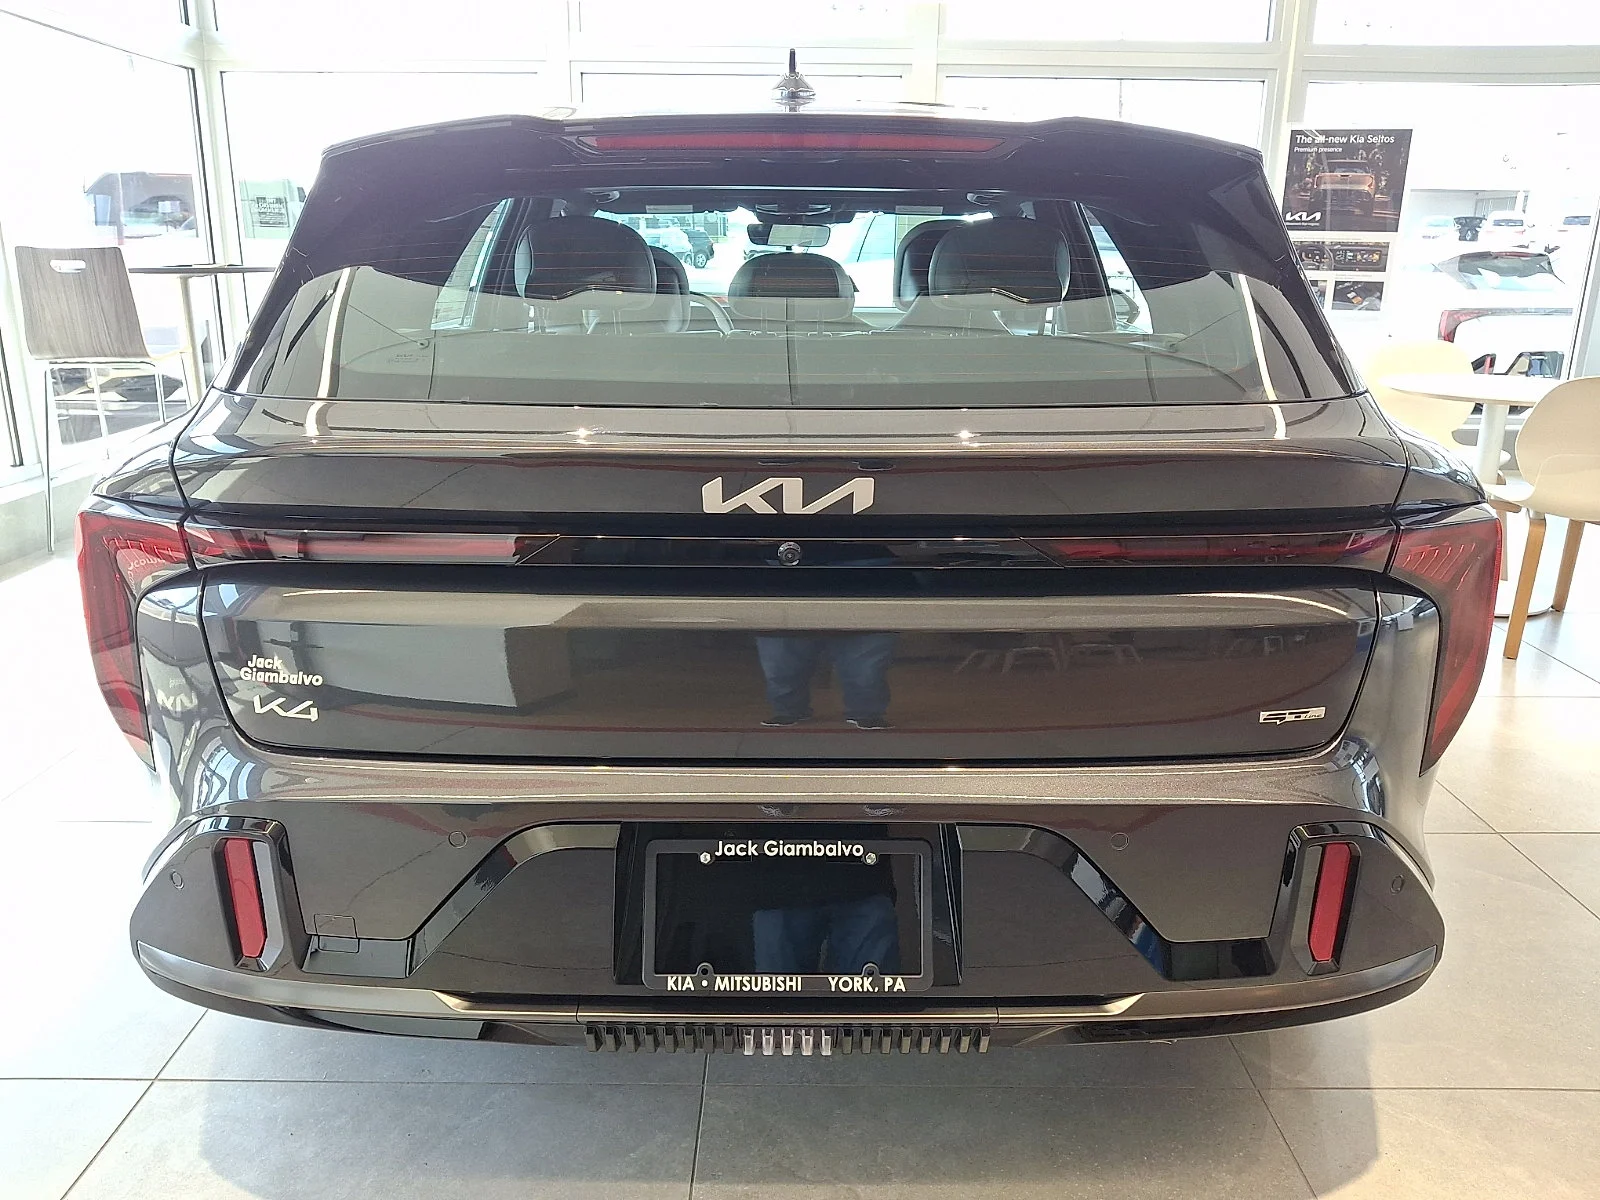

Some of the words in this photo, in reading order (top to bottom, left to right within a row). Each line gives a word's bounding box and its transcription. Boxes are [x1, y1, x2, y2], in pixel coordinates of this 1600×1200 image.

[1295, 134, 1312, 144] The
[1314, 134, 1348, 144] all-new
[1349, 134, 1365, 144] Kia
[1366, 134, 1395, 144] Seltos
[1285, 211, 1322, 221] KIA
[702, 476, 875, 515] KIA
[247, 654, 283, 670] Jack
[239, 667, 324, 686] Giambalvo
[253, 694, 319, 722] K4
[714, 840, 760, 857] Jack
[763, 839, 864, 857] Giambalvo
[666, 976, 695, 991] KIA
[714, 976, 802, 992] MITSUBISHI
[827, 976, 879, 993] YORK,
[884, 976, 907, 992] PA
